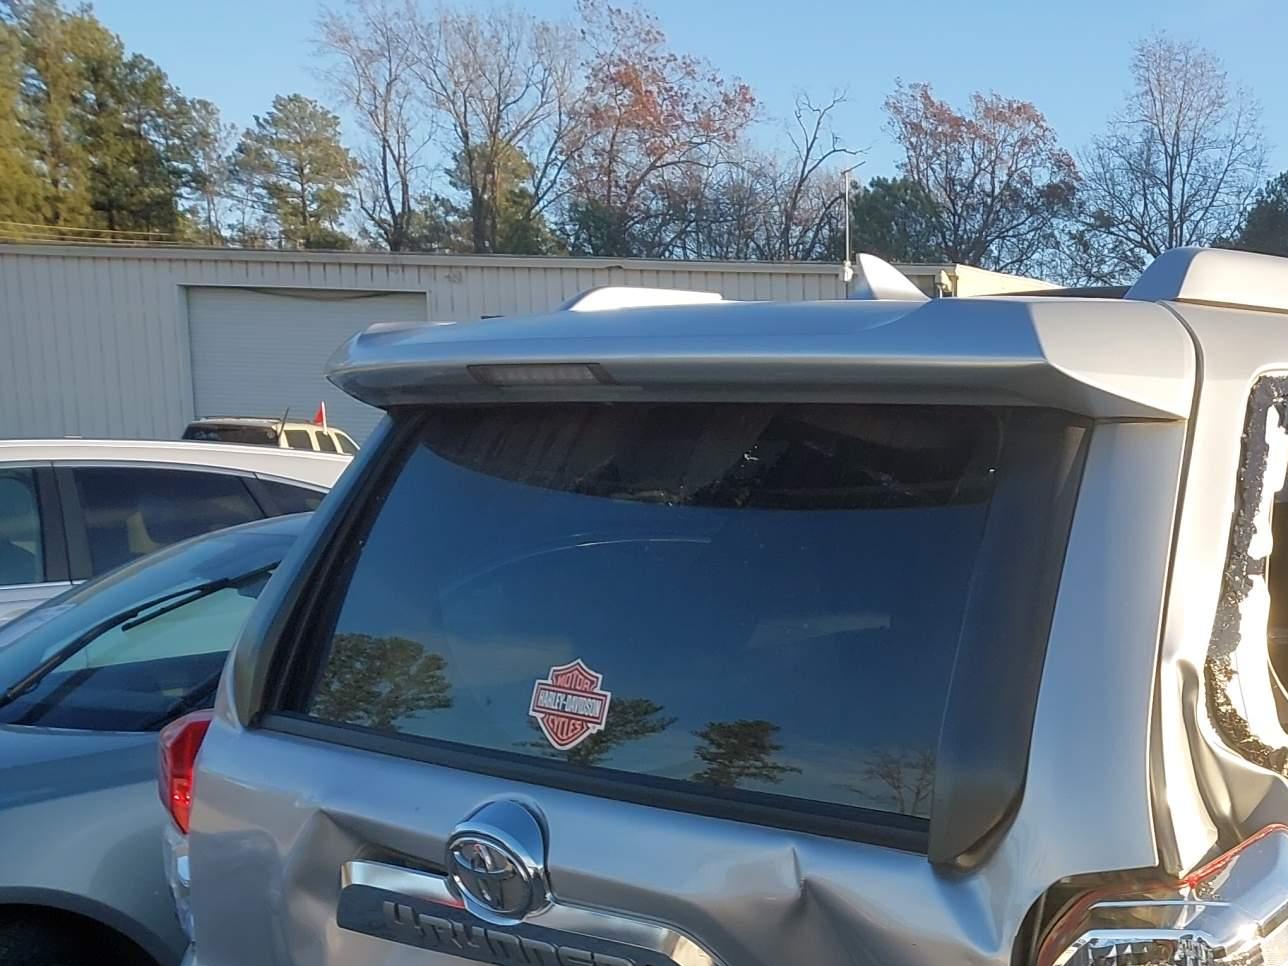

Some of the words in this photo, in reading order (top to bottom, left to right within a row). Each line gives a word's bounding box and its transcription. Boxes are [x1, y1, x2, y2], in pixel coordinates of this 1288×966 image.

[553, 670, 593, 691] MOTOR
[537, 688, 603, 718] HARLEY-DAVIDSON
[547, 714, 584, 740] CYCLES
